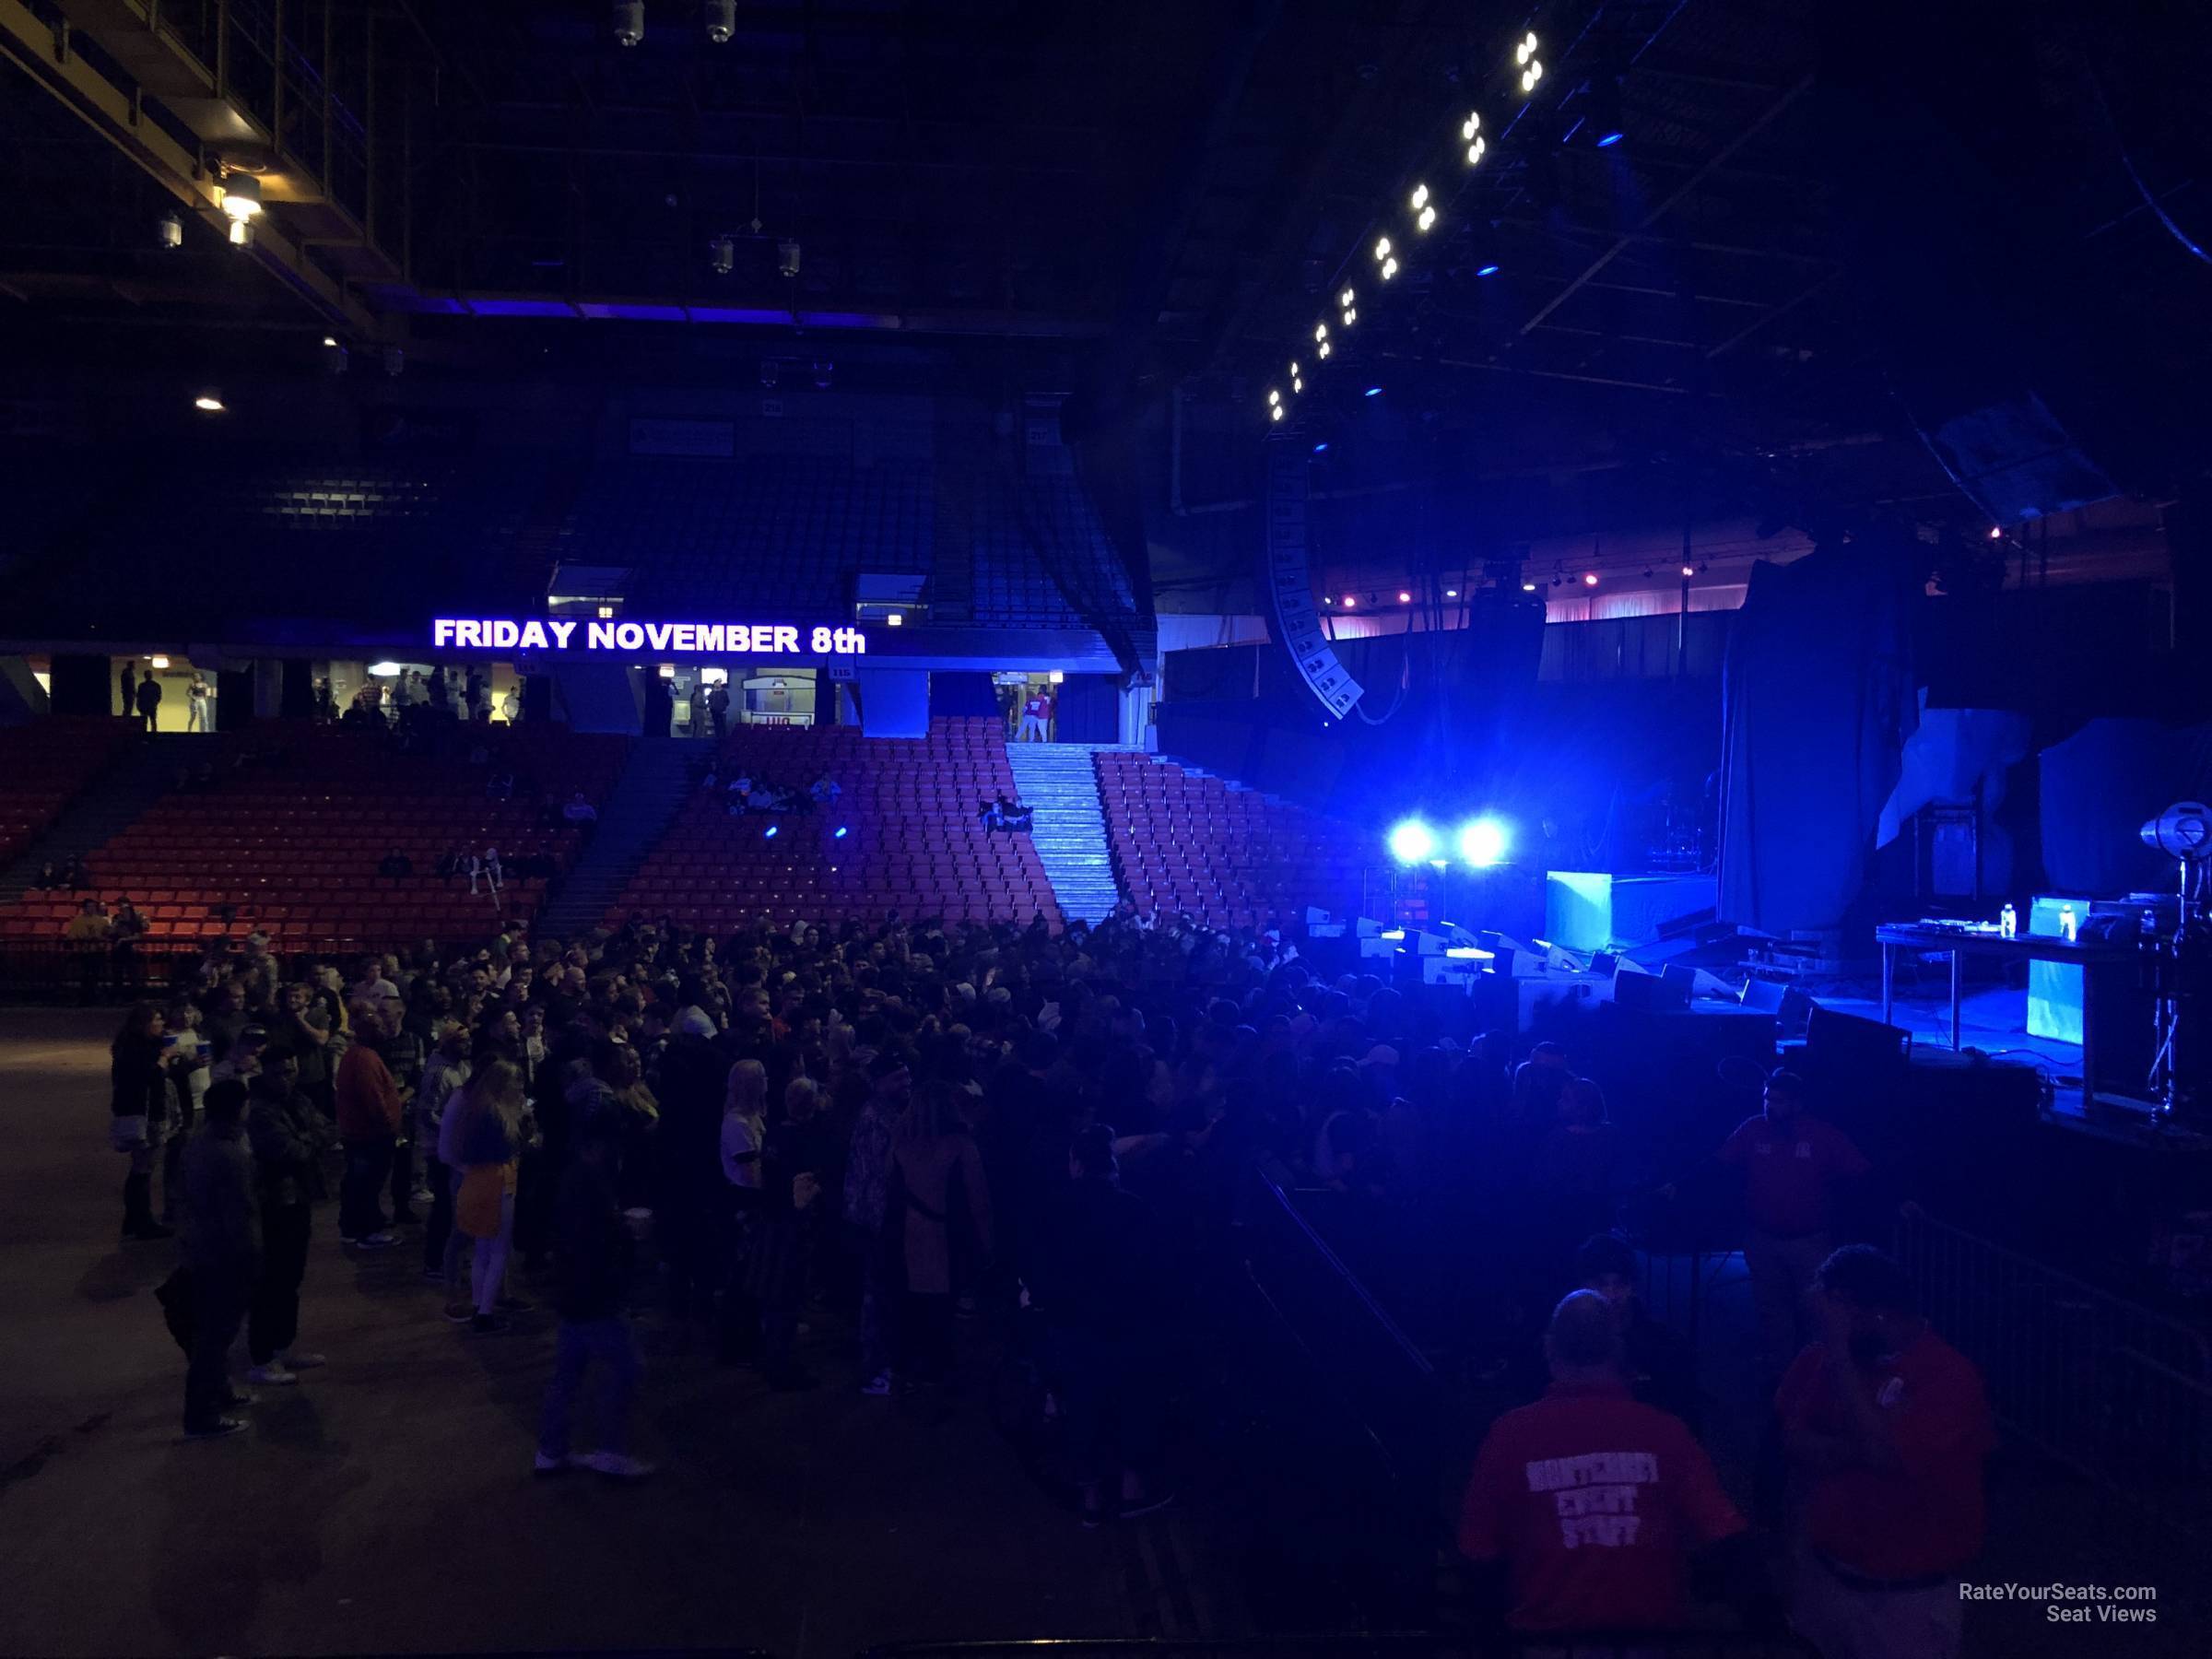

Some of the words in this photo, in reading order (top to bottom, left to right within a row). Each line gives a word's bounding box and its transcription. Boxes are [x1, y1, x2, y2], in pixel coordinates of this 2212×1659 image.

[434, 619, 576, 649] FRIDAY
[588, 622, 800, 653] NOVEMBER
[811, 628, 865, 653] 8th
